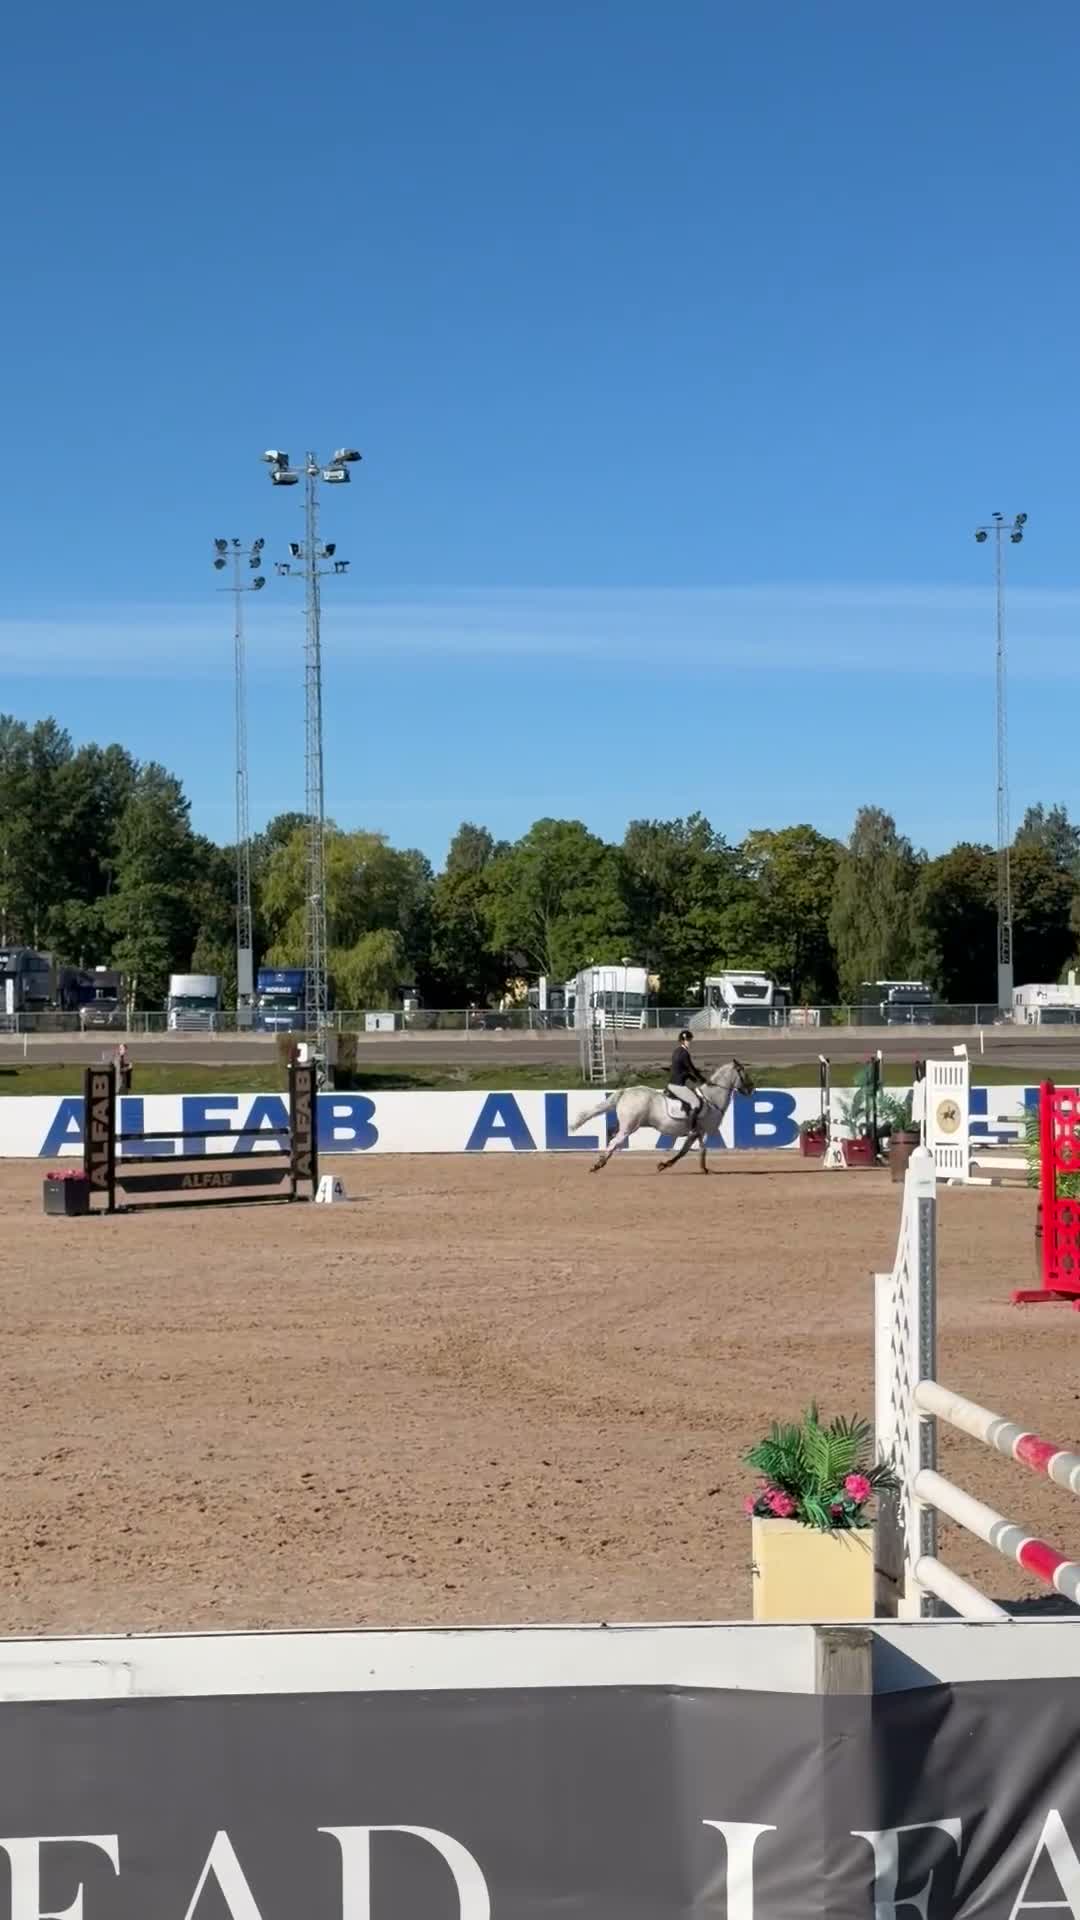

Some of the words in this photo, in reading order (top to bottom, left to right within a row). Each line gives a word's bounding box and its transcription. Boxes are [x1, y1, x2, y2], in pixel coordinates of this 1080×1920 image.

[92, 1074, 109, 1187] ALFAB
[295, 1070, 312, 1176] ALFAB
[465, 1090, 800, 1151] ALB
[334, 1181, 344, 1195] 4
